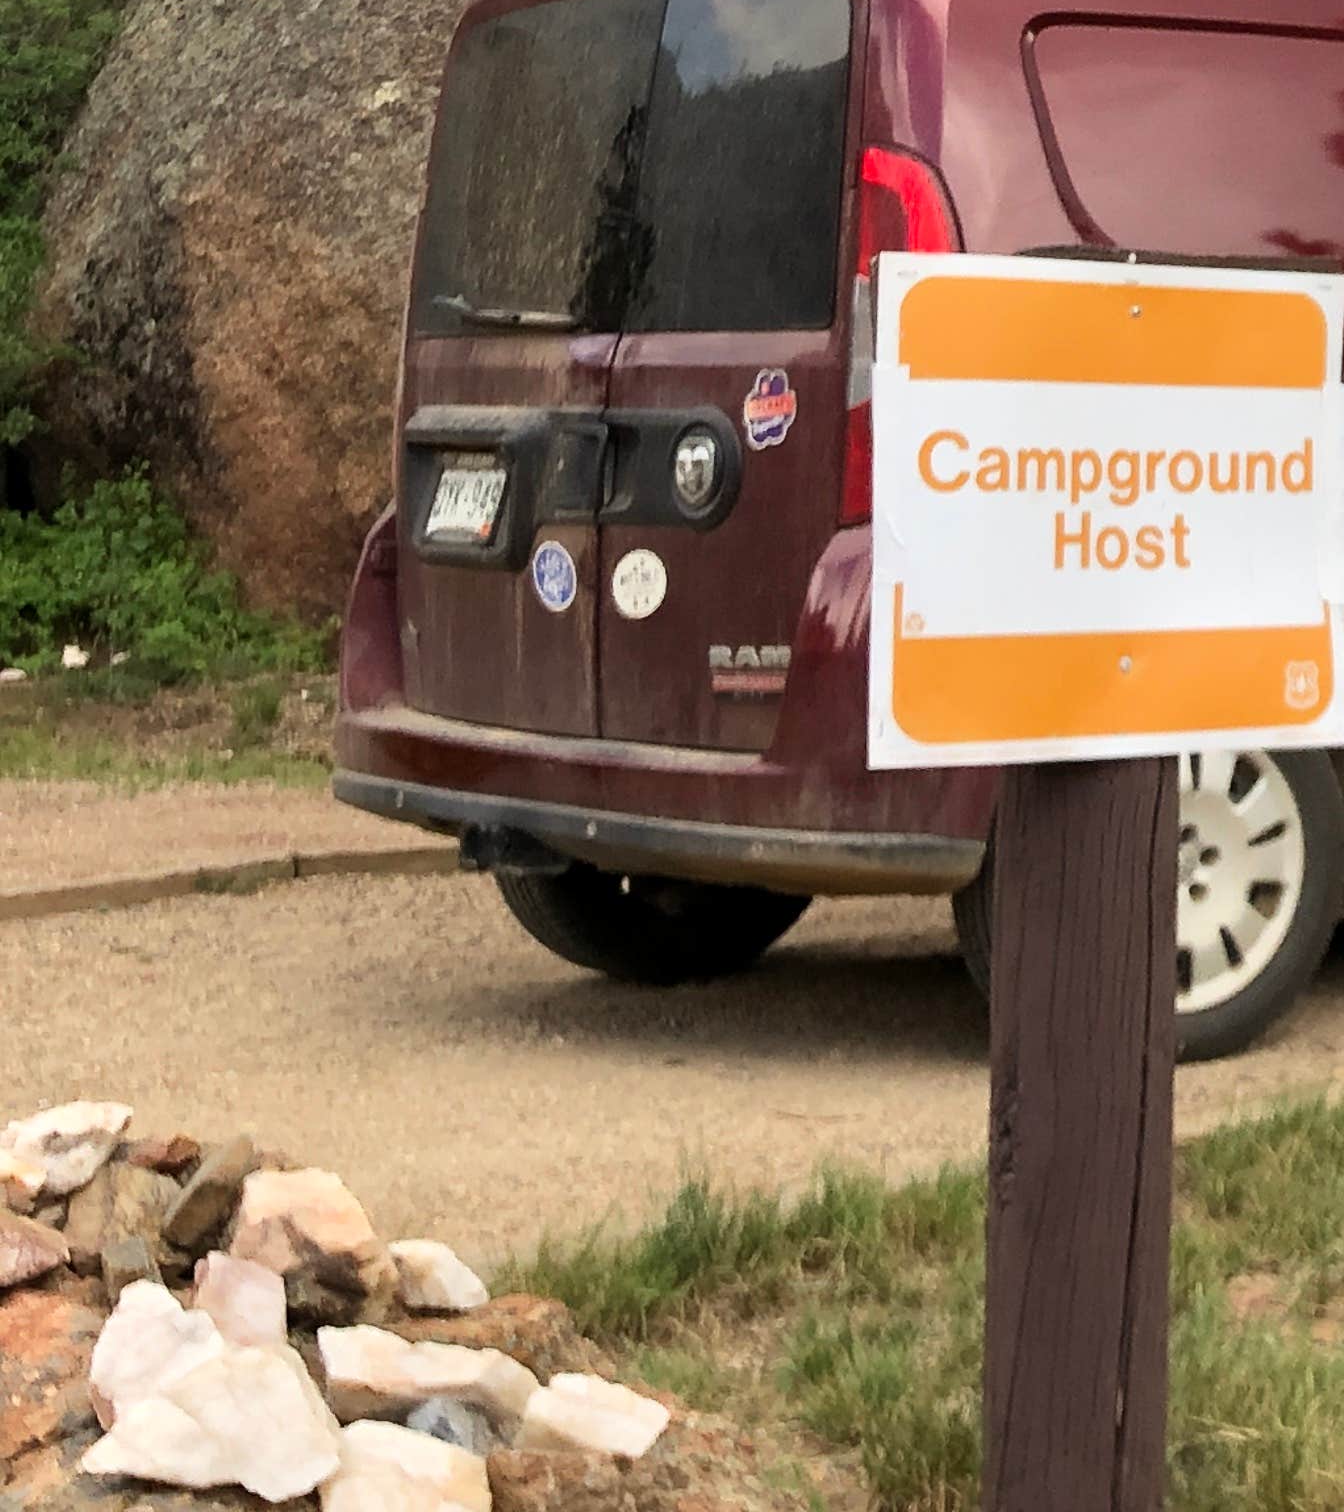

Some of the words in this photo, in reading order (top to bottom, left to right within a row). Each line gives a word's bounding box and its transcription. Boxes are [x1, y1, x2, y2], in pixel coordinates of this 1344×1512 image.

[917, 429, 1314, 506] Campground
[1053, 511, 1192, 570] Host
[708, 644, 792, 668] RAM
